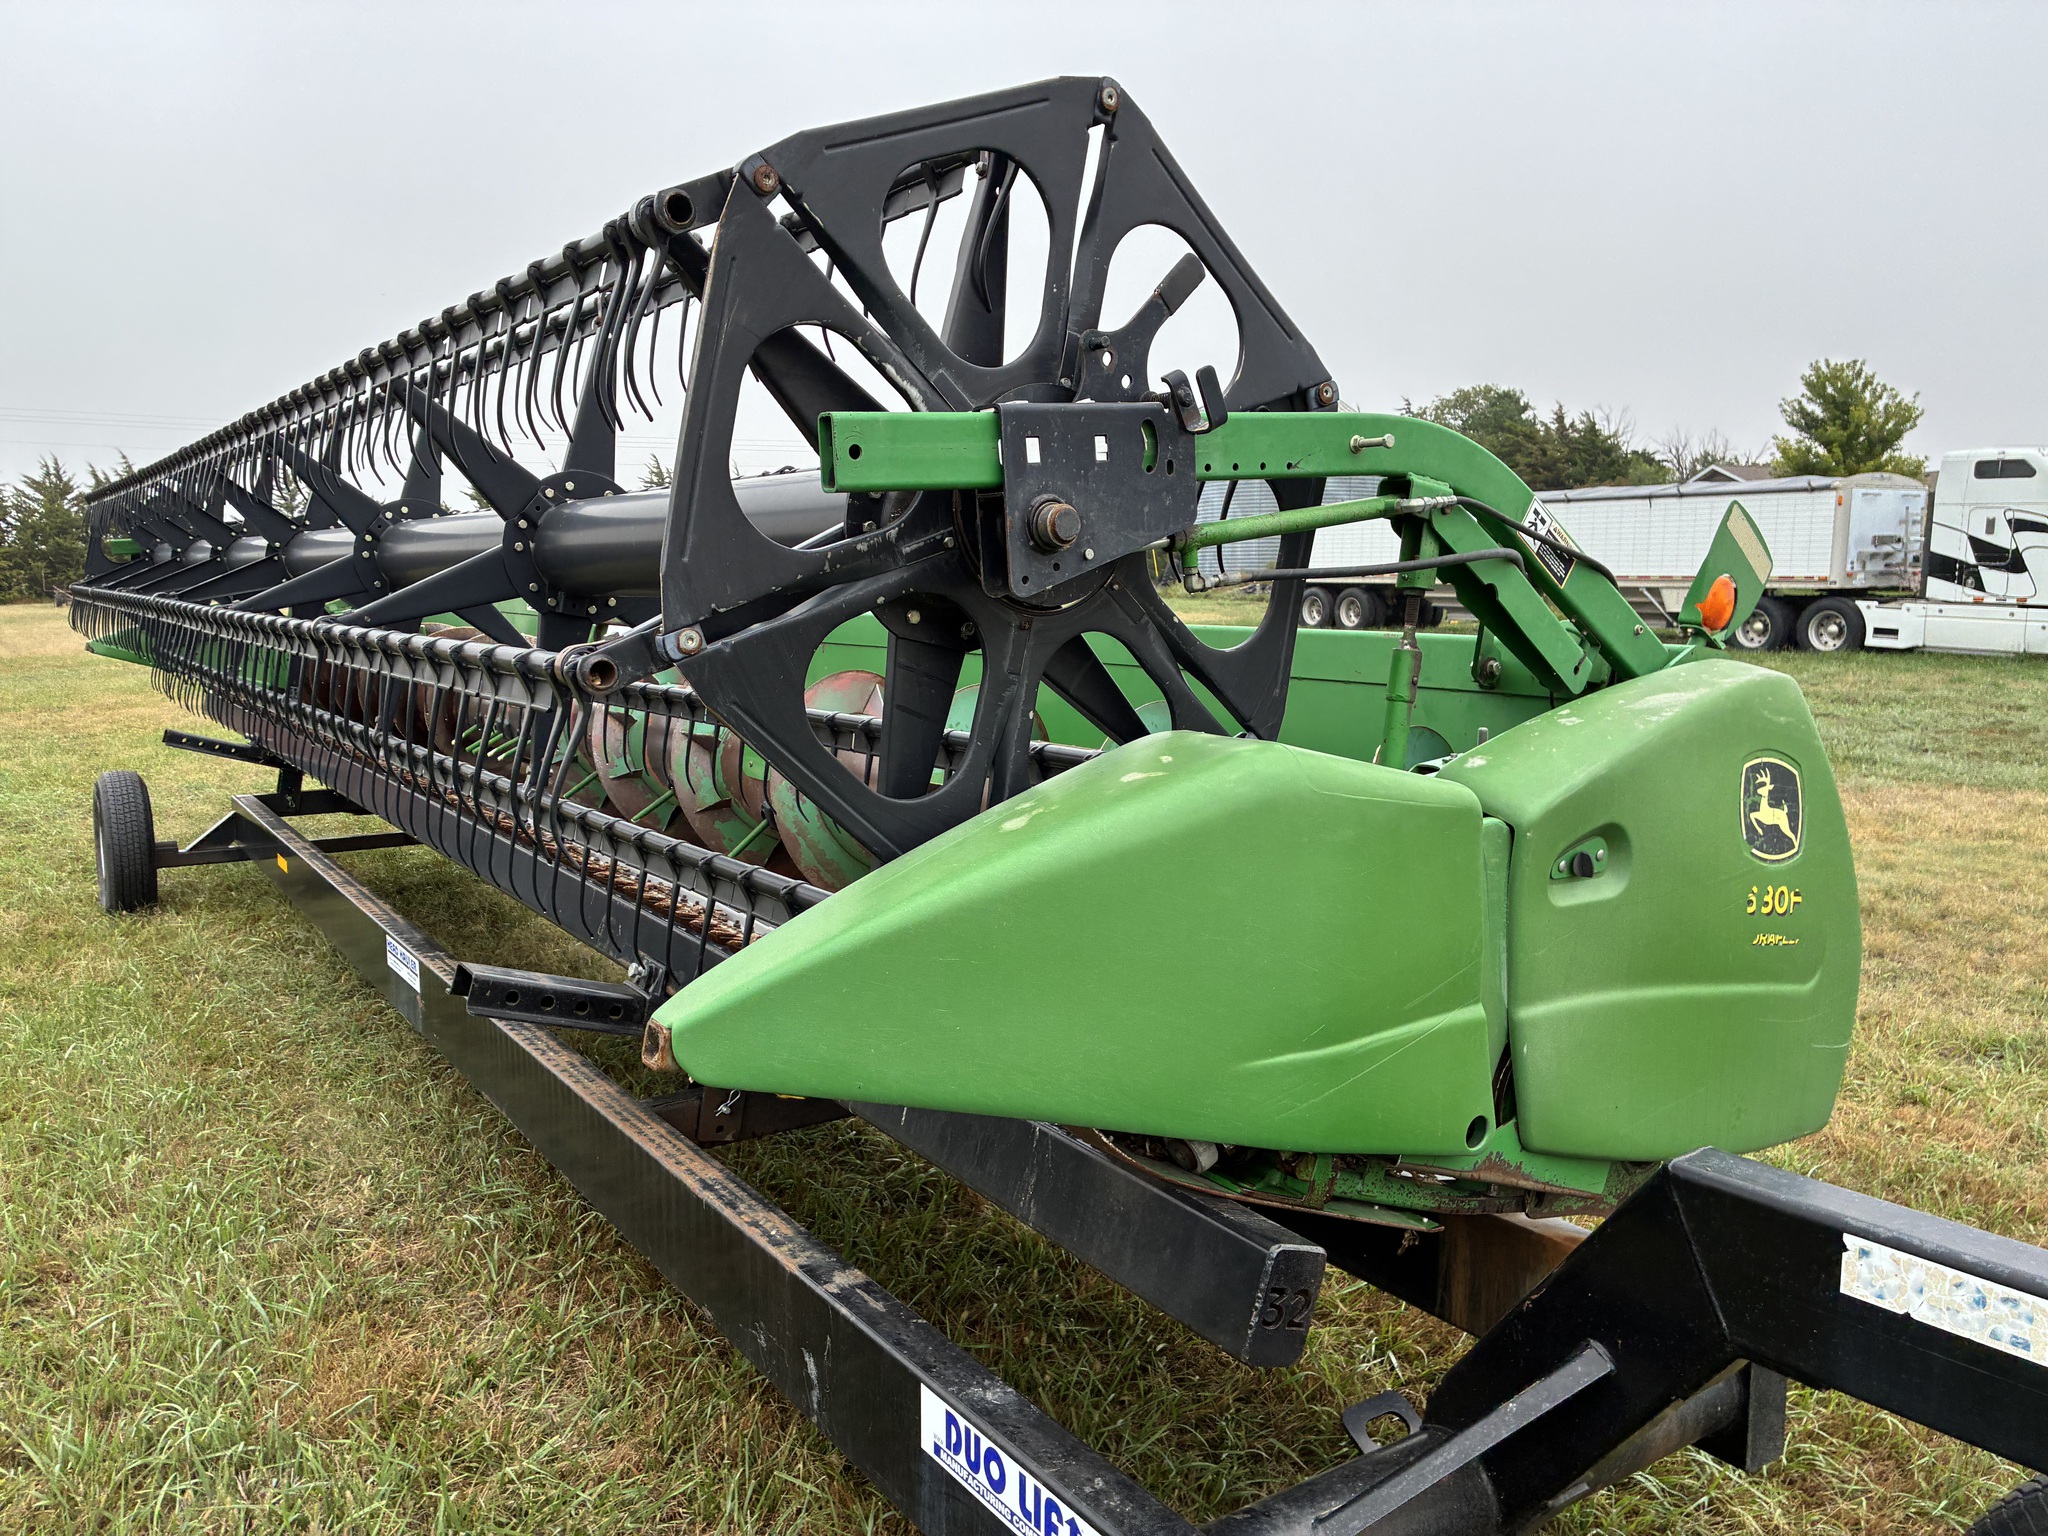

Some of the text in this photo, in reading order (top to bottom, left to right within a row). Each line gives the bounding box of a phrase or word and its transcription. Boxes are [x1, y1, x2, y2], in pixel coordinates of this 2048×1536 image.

[1261, 1286, 1313, 1330] 32
[939, 1449, 1012, 1520] MANUFACTURING
[945, 1408, 1006, 1495] DUO
